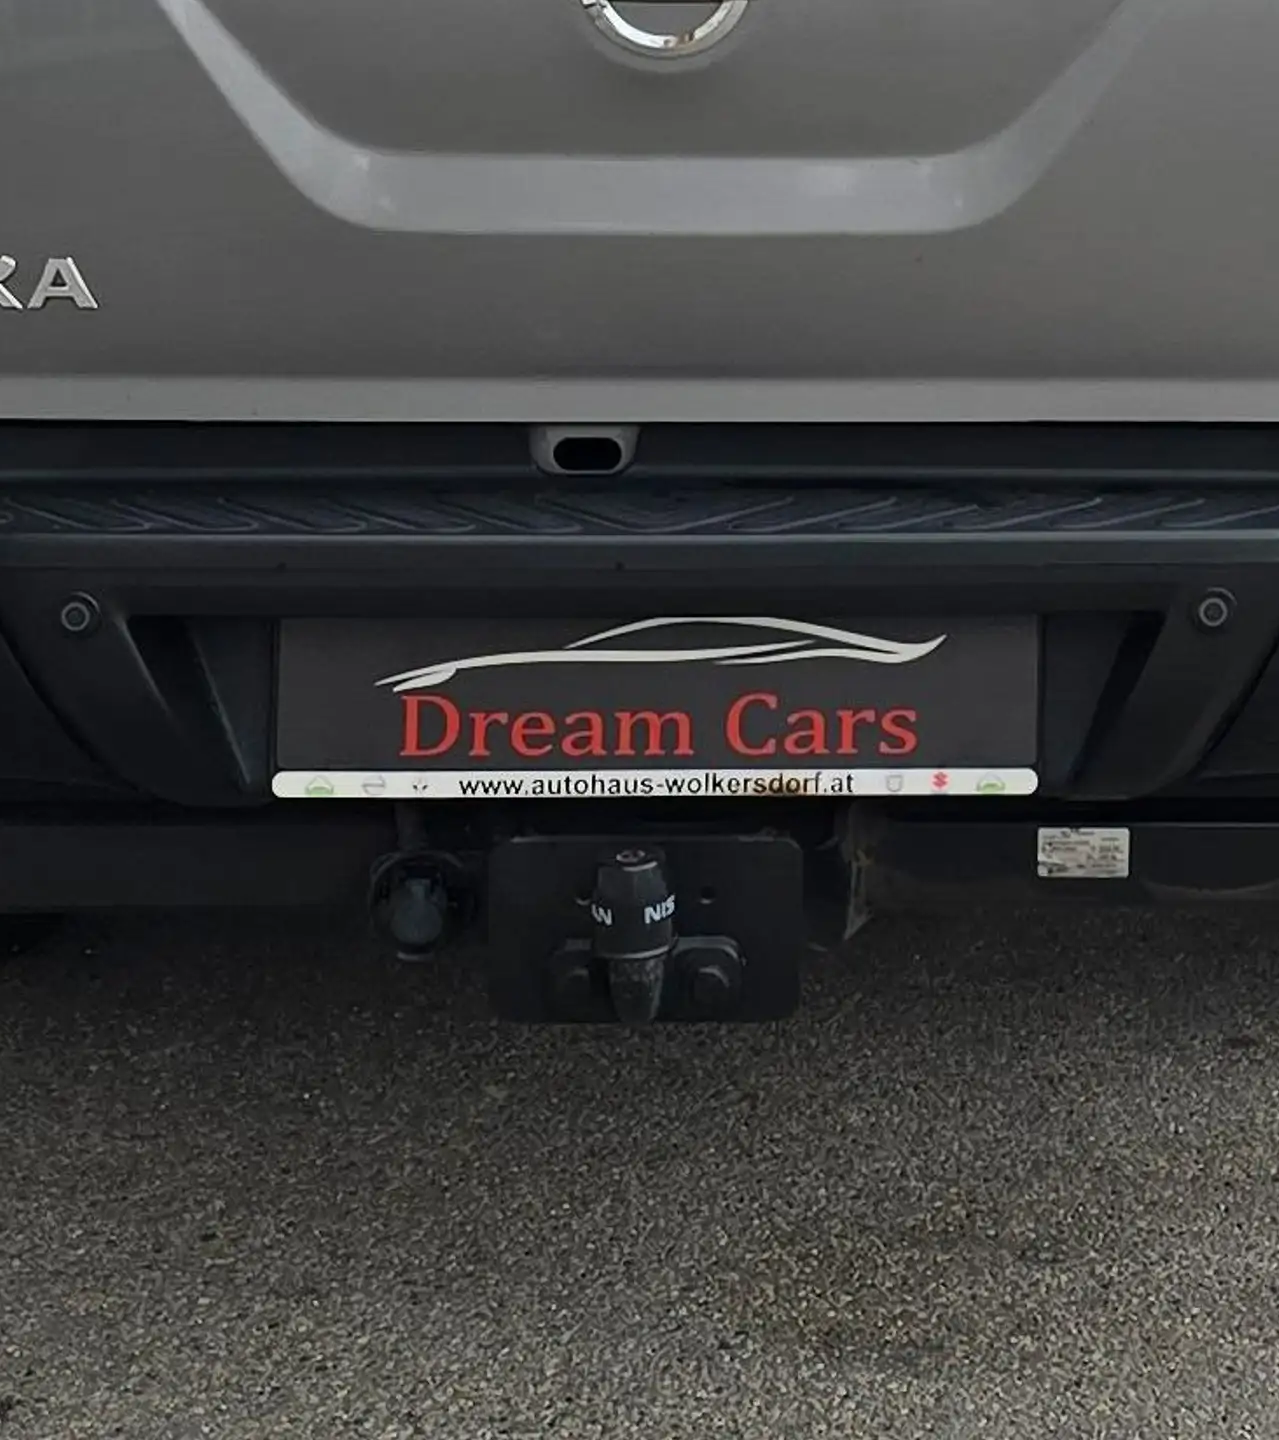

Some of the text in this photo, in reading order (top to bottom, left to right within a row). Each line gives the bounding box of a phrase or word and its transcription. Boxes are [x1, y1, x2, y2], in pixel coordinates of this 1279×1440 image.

[399, 691, 919, 758] Dream Cars
[458, 771, 855, 796] www.autohaus-wolkersdorf.at
